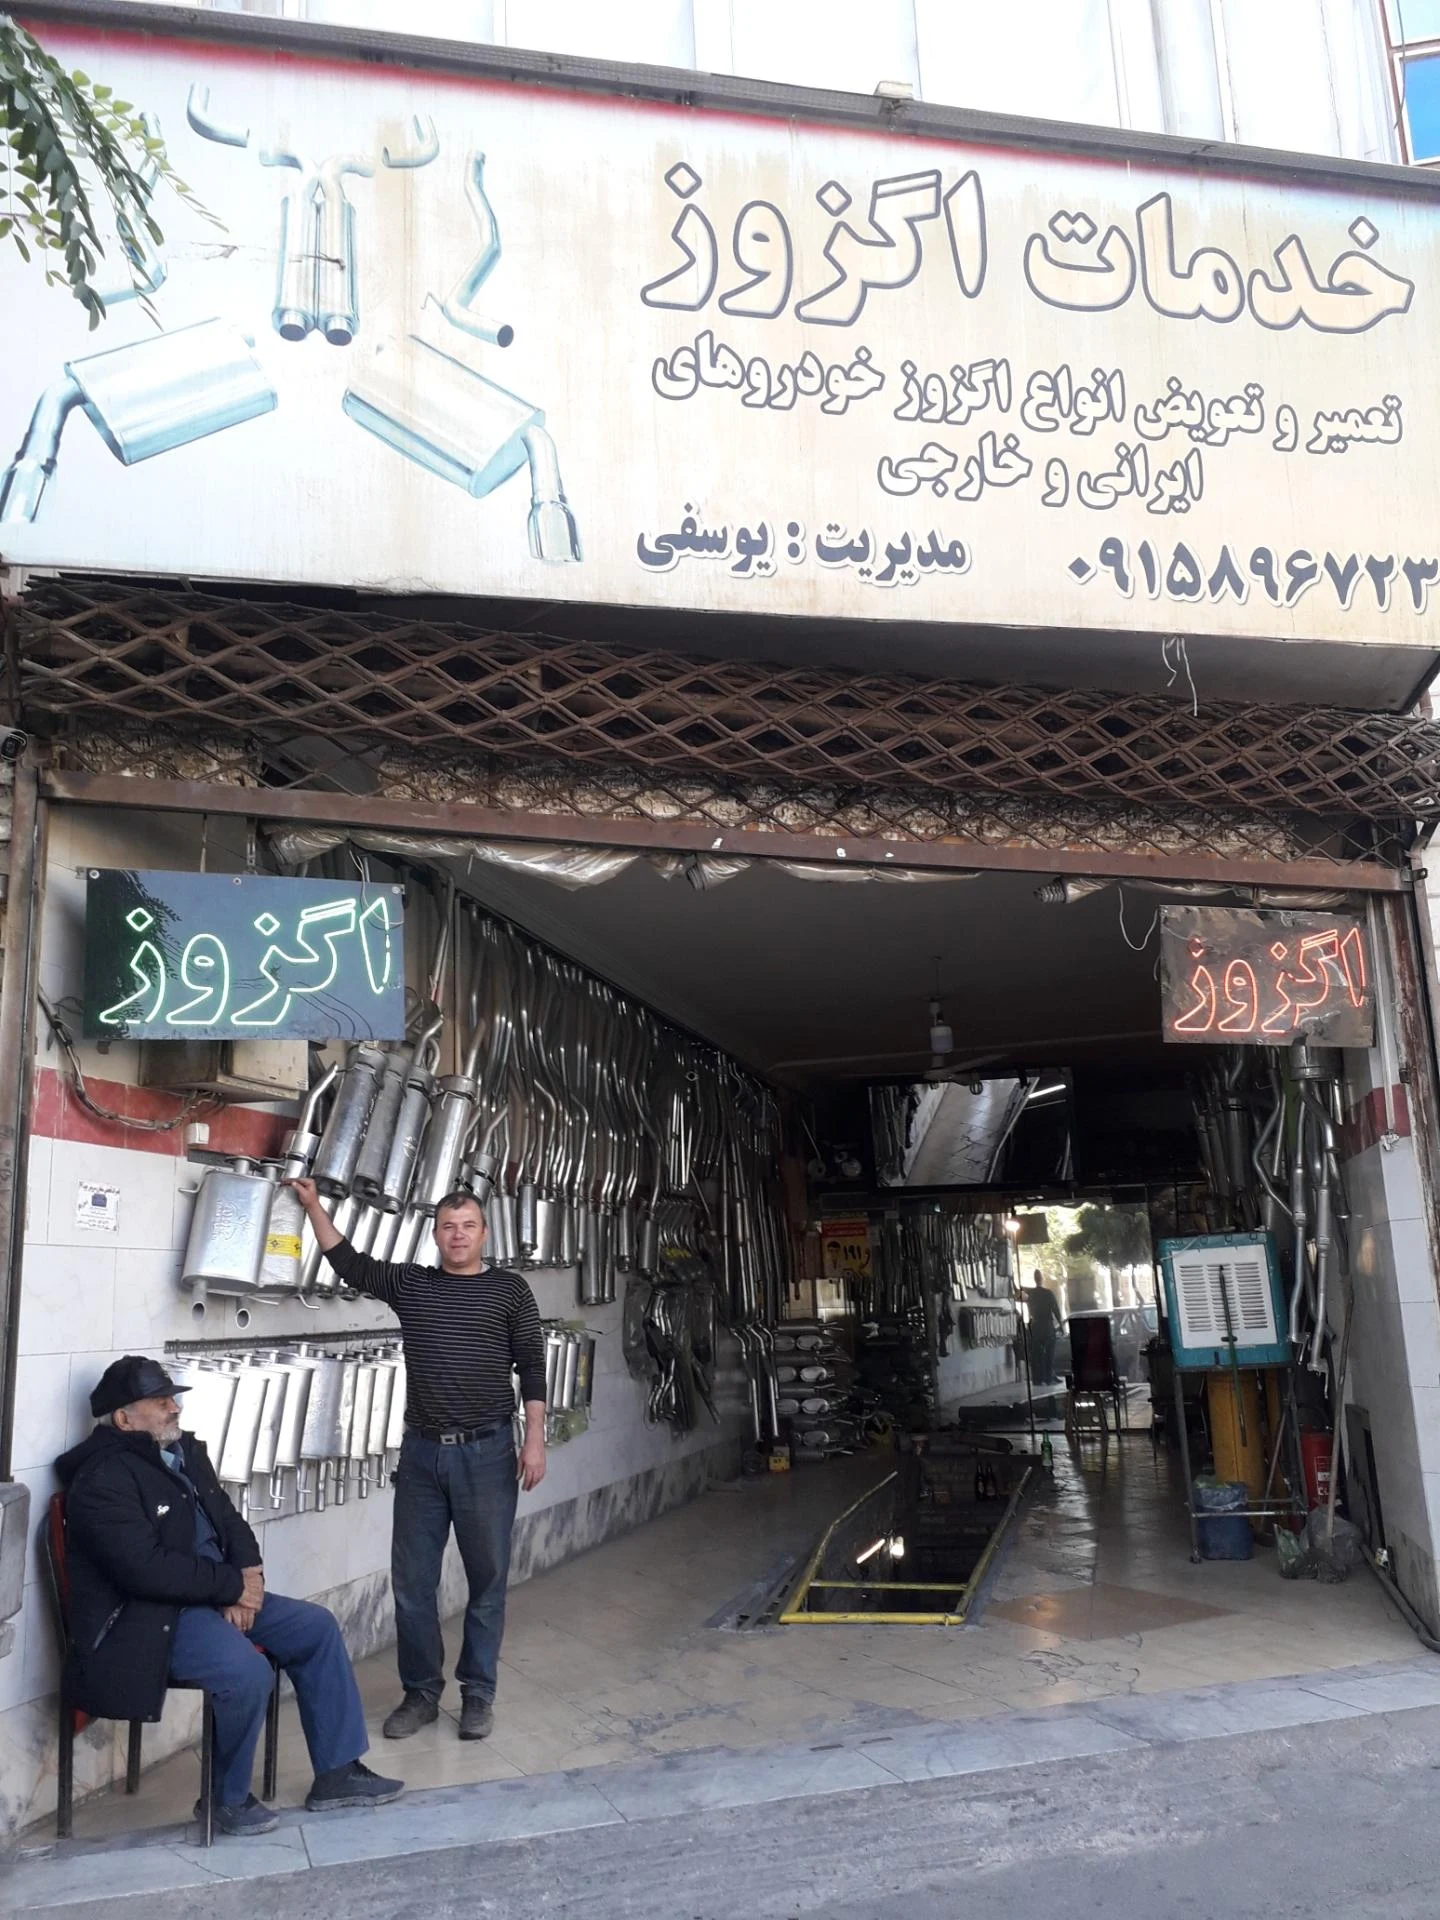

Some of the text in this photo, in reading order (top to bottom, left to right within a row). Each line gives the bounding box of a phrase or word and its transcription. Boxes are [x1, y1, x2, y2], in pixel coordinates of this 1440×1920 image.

[640, 162, 1415, 334] خدمات اگزوز
[651, 329, 1403, 453] تعمیر و تعویض انواع اگزوز خودروهای
[877, 431, 1203, 515] ایرانی و خارجی
[636, 501, 770, 574] یوسفی
[815, 522, 970, 583] مدیریت
[99, 896, 391, 1026] اگزوز
[1174, 927, 1366, 1033] اگزوز
